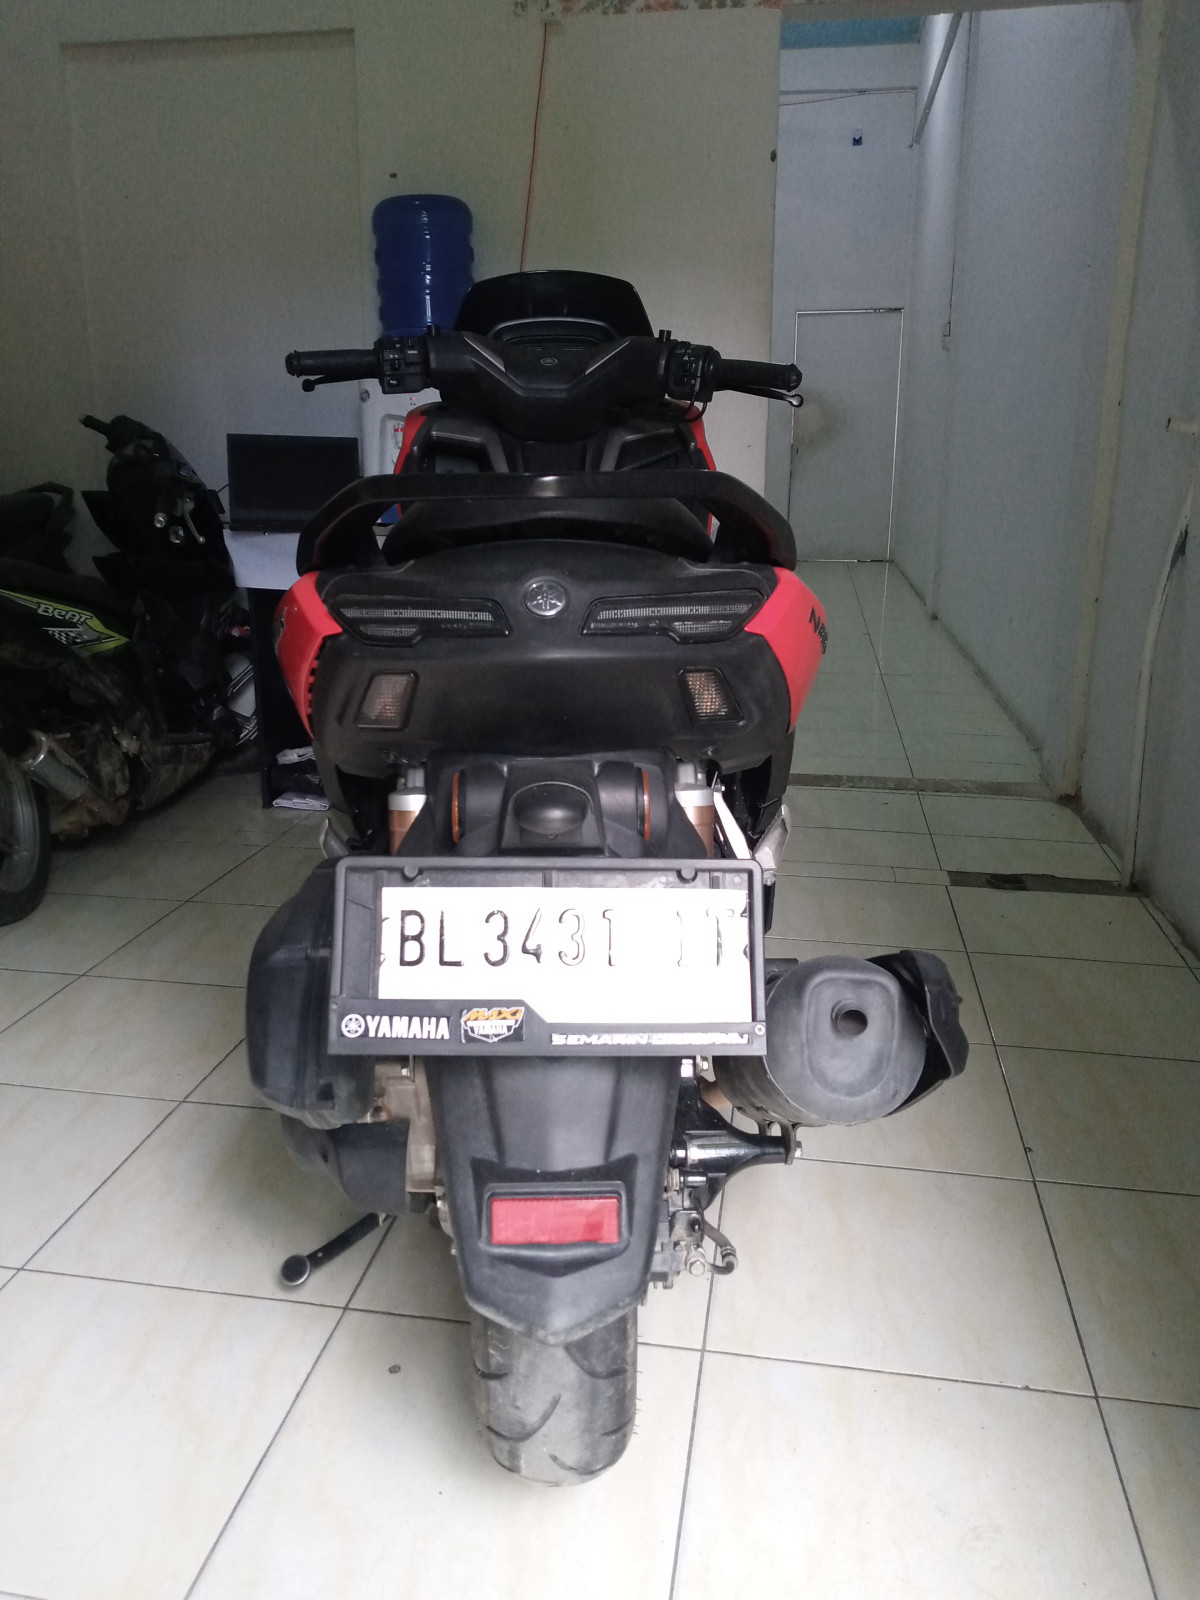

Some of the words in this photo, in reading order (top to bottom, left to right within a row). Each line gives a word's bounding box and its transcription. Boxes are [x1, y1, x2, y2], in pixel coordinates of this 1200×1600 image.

[399, 909, 464, 967] BL
[483, 907, 617, 967] 3431
[464, 1008, 524, 1021] MAXI
[366, 1015, 449, 1039] YAMAHA
